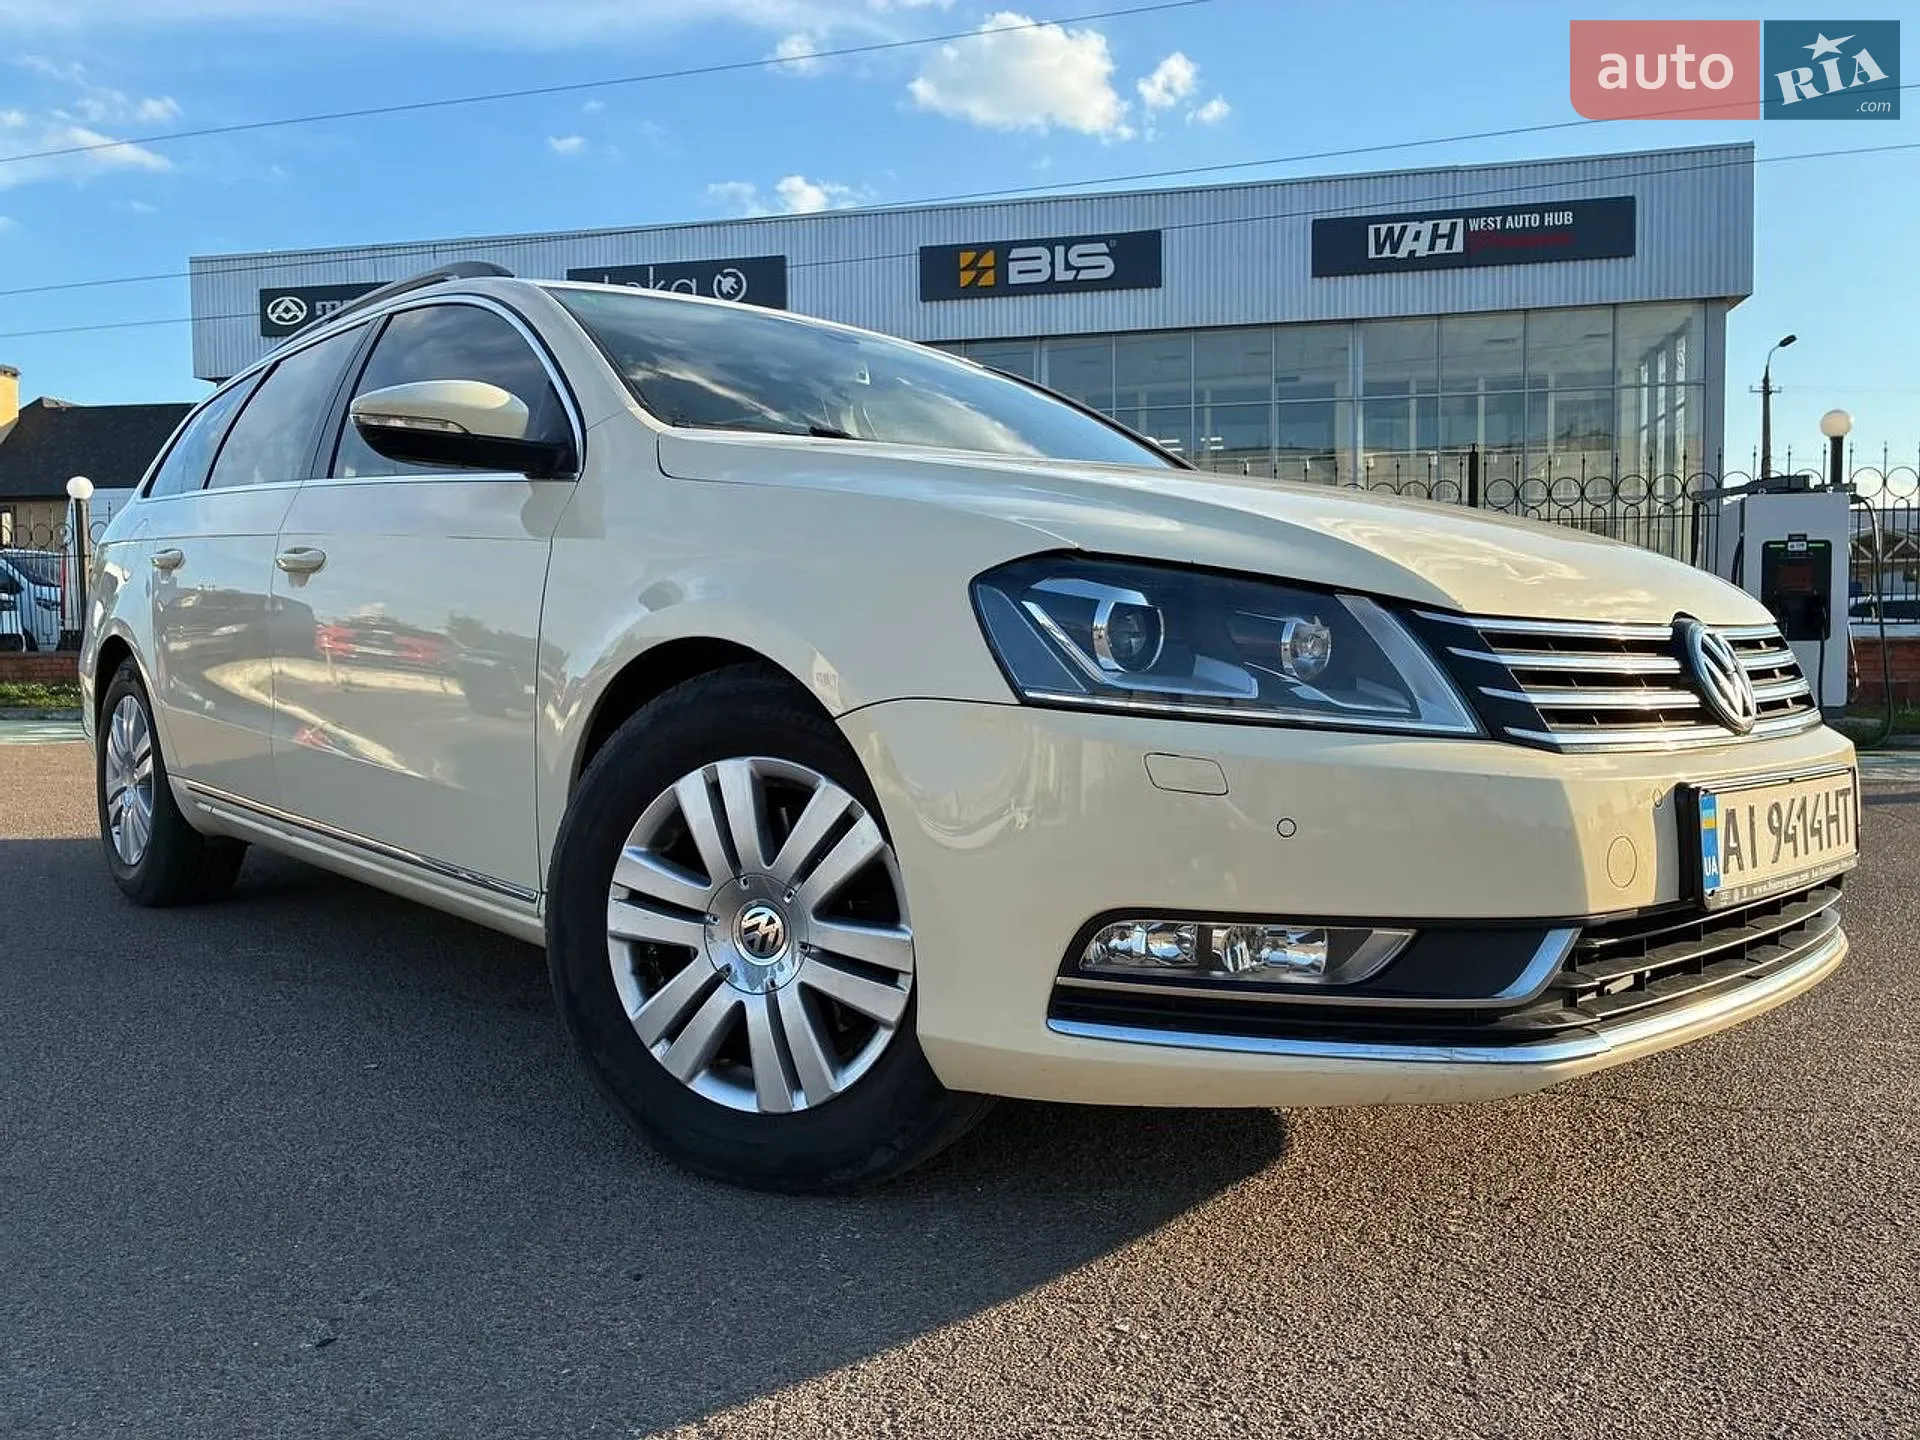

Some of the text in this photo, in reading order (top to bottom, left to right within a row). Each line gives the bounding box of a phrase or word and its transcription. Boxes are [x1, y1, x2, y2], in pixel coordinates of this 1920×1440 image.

[1368, 218, 1464, 260] WAH
[1468, 210, 1574, 232] WEST AUTO HUB
[1007, 242, 1116, 286] BLS
[1722, 786, 1852, 875] AI 9414HT
[1704, 855, 1720, 878] UA
